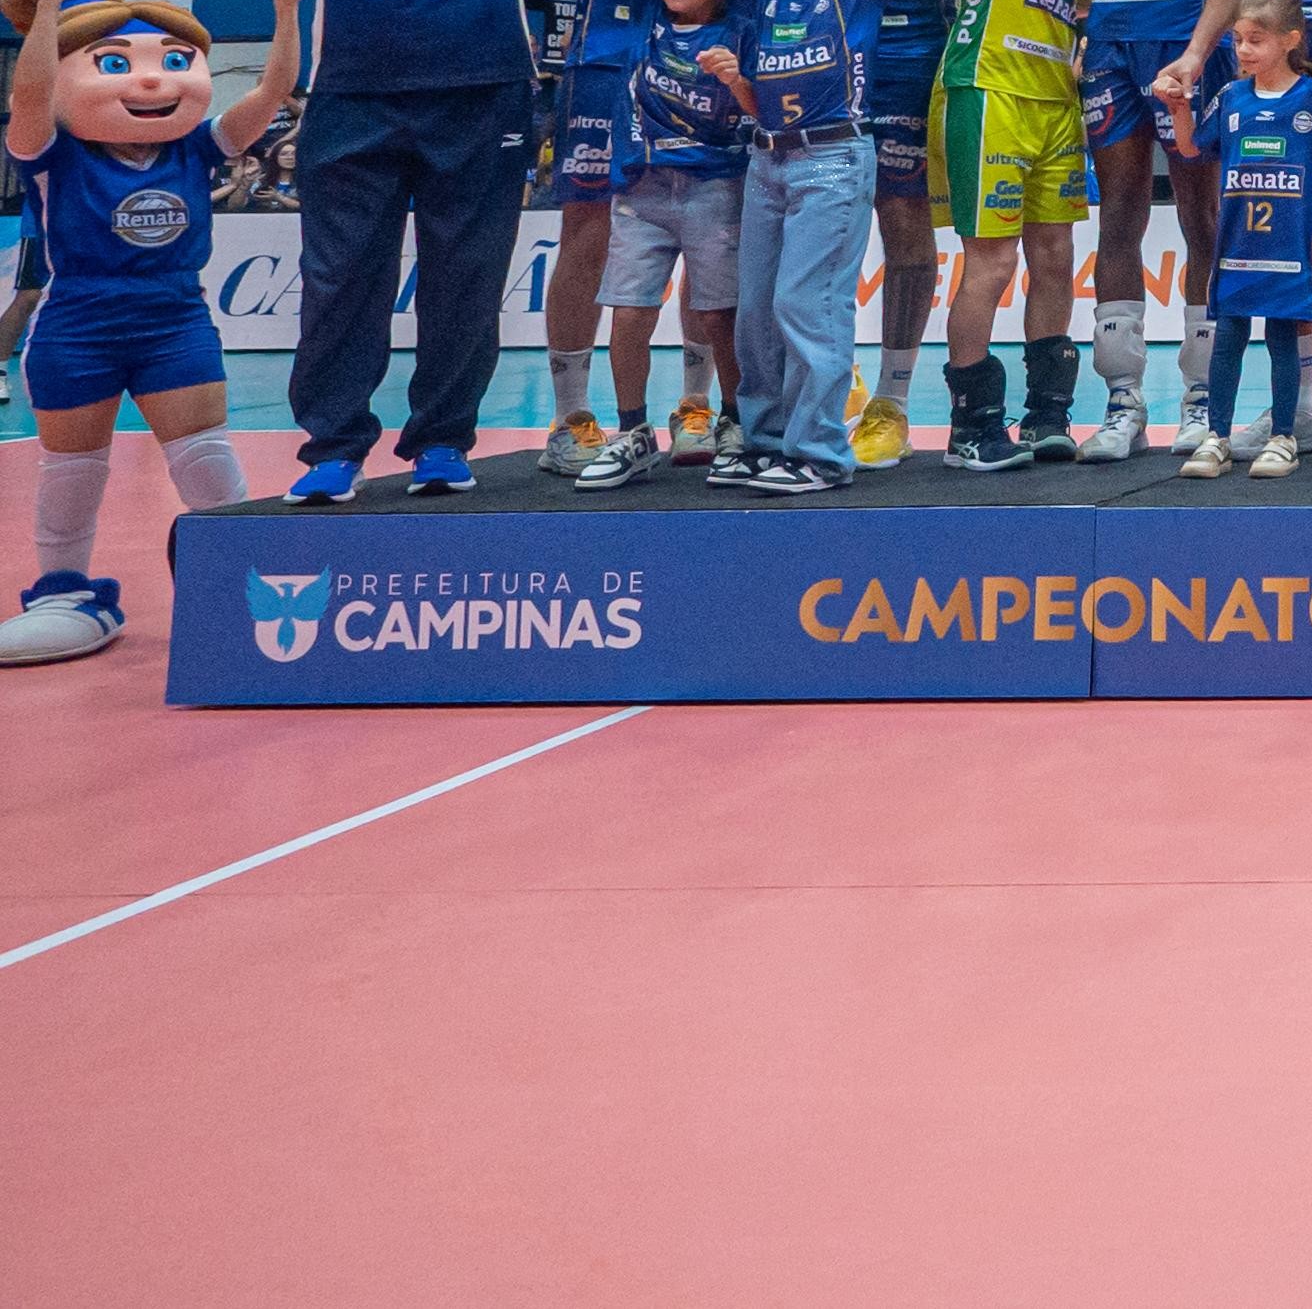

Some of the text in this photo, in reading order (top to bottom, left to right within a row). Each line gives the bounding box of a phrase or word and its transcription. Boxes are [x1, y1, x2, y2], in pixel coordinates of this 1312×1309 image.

[757, 44, 831, 73] Renata
[644, 66, 712, 113] Renta
[782, 93, 803, 125] 5
[1244, 141, 1281, 152] Unimed
[1225, 170, 1300, 191] Renata
[114, 209, 188, 229] Renata
[1246, 201, 1273, 232] 12
[336, 571, 645, 596] PREFEITURA DE
[335, 598, 643, 652] CAMPINAS
